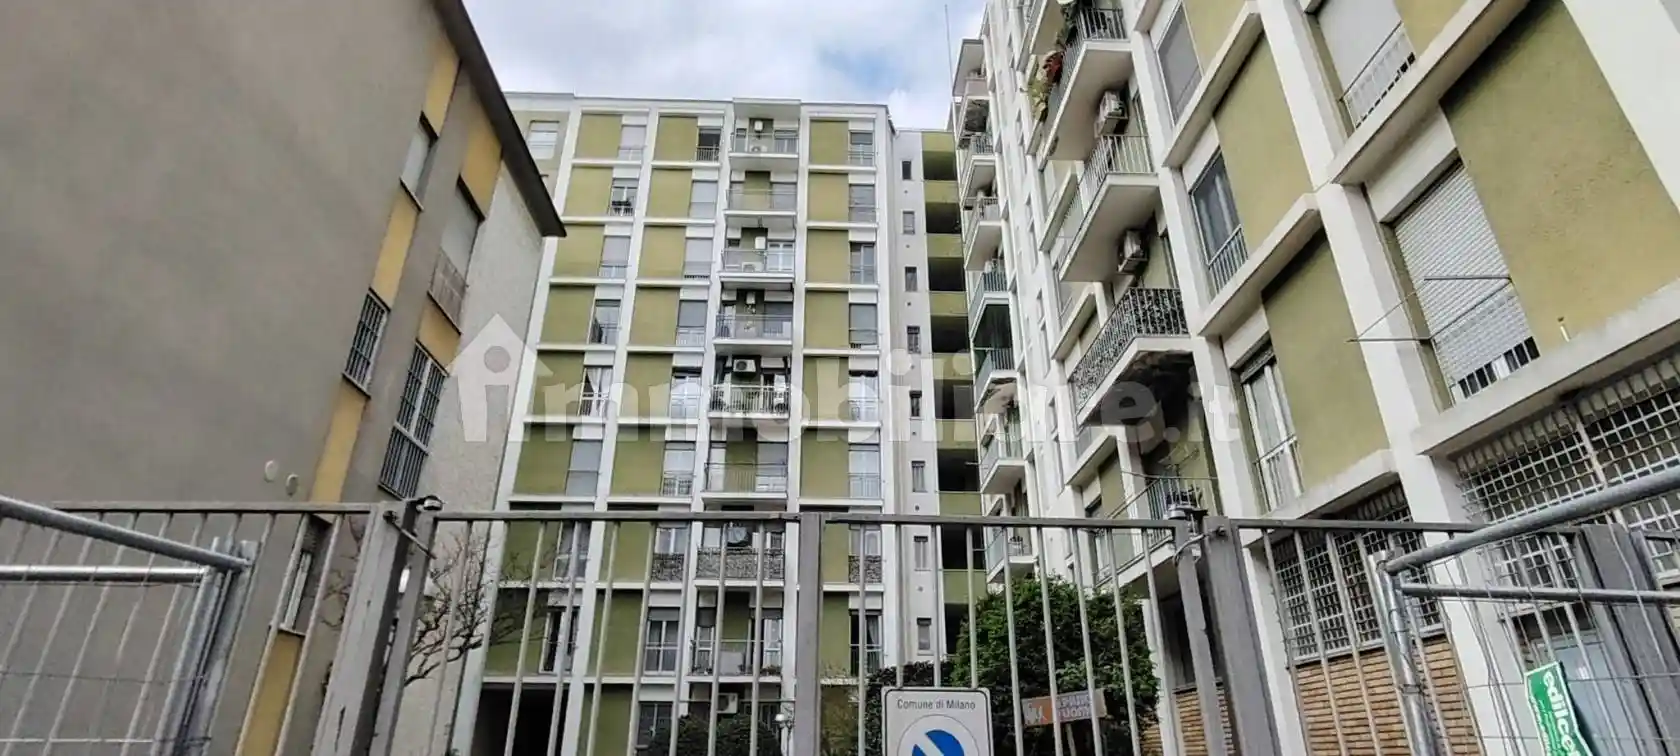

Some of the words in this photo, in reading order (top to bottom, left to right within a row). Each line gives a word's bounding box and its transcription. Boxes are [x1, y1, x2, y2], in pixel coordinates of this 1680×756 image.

[897, 699, 933, 710] Comune
[935, 699, 944, 709] di
[946, 700, 976, 710] Milano
